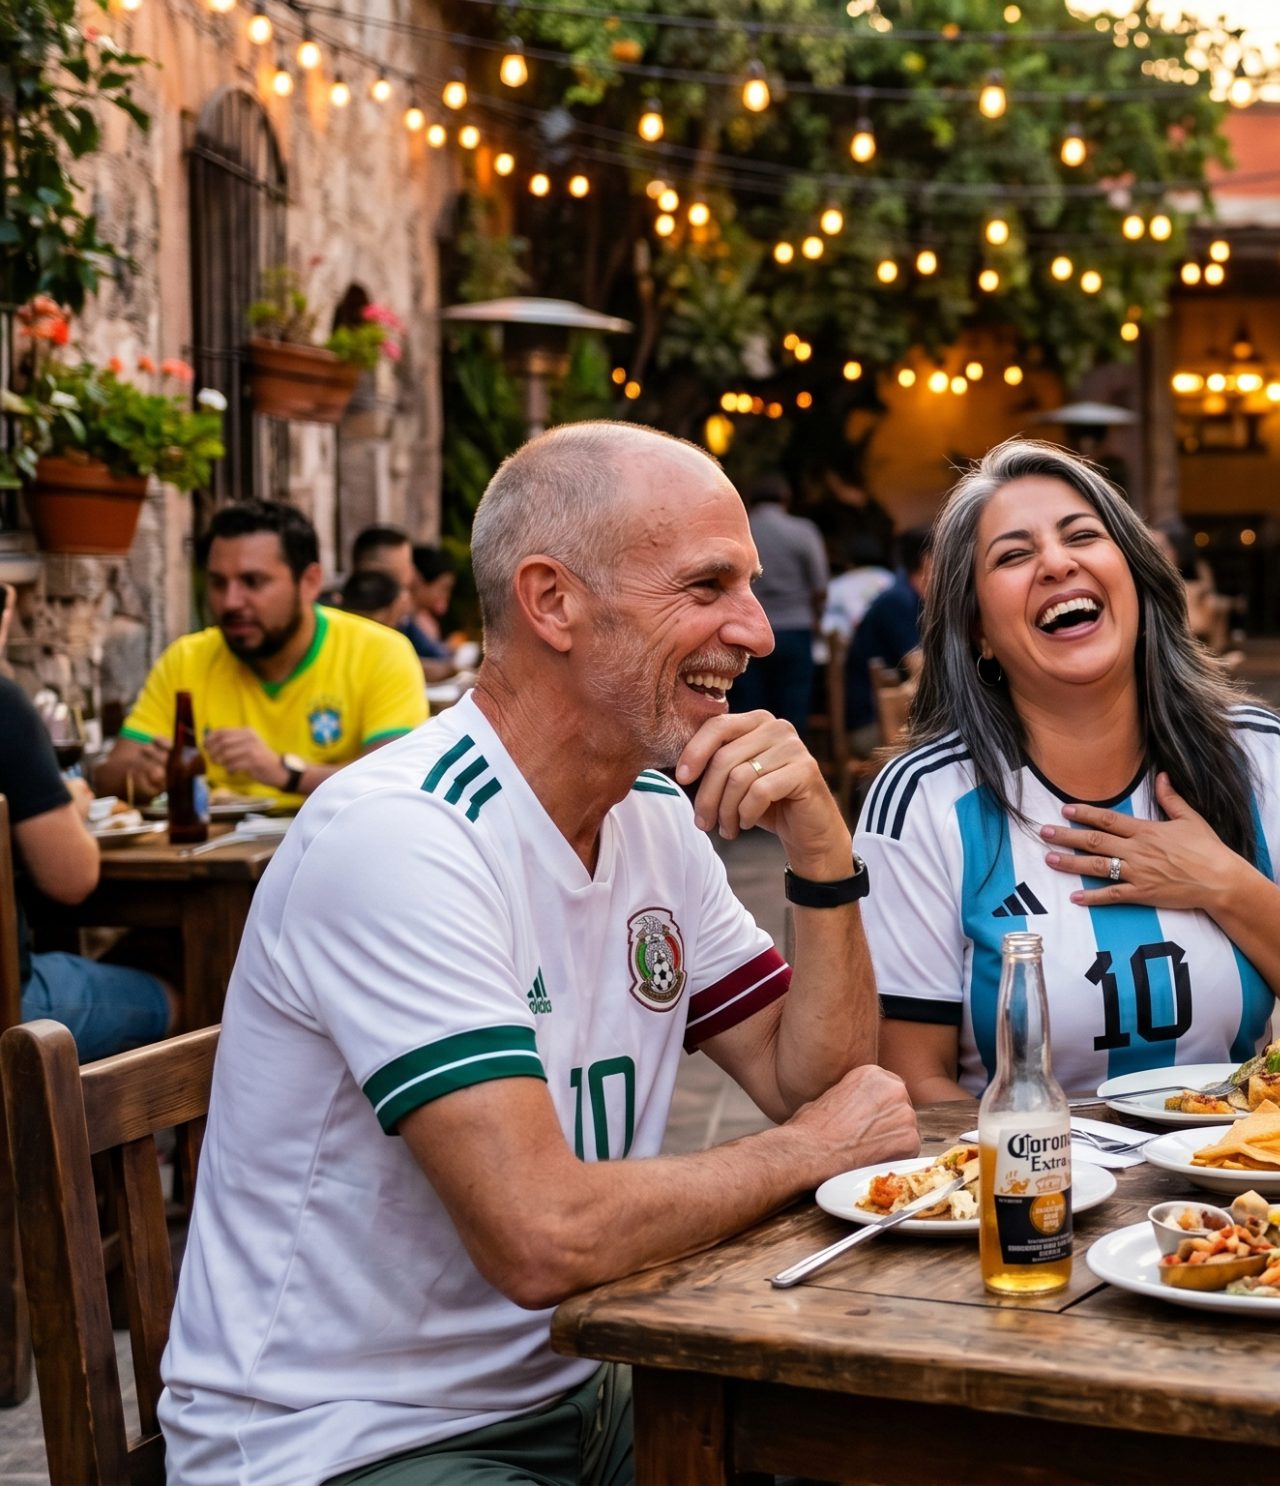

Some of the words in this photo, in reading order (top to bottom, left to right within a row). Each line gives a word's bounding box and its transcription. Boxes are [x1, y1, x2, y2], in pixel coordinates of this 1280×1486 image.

[1084, 940, 1193, 1051] 10
[570, 1055, 636, 1162] 10
[1031, 1156, 1067, 1172] Extra
